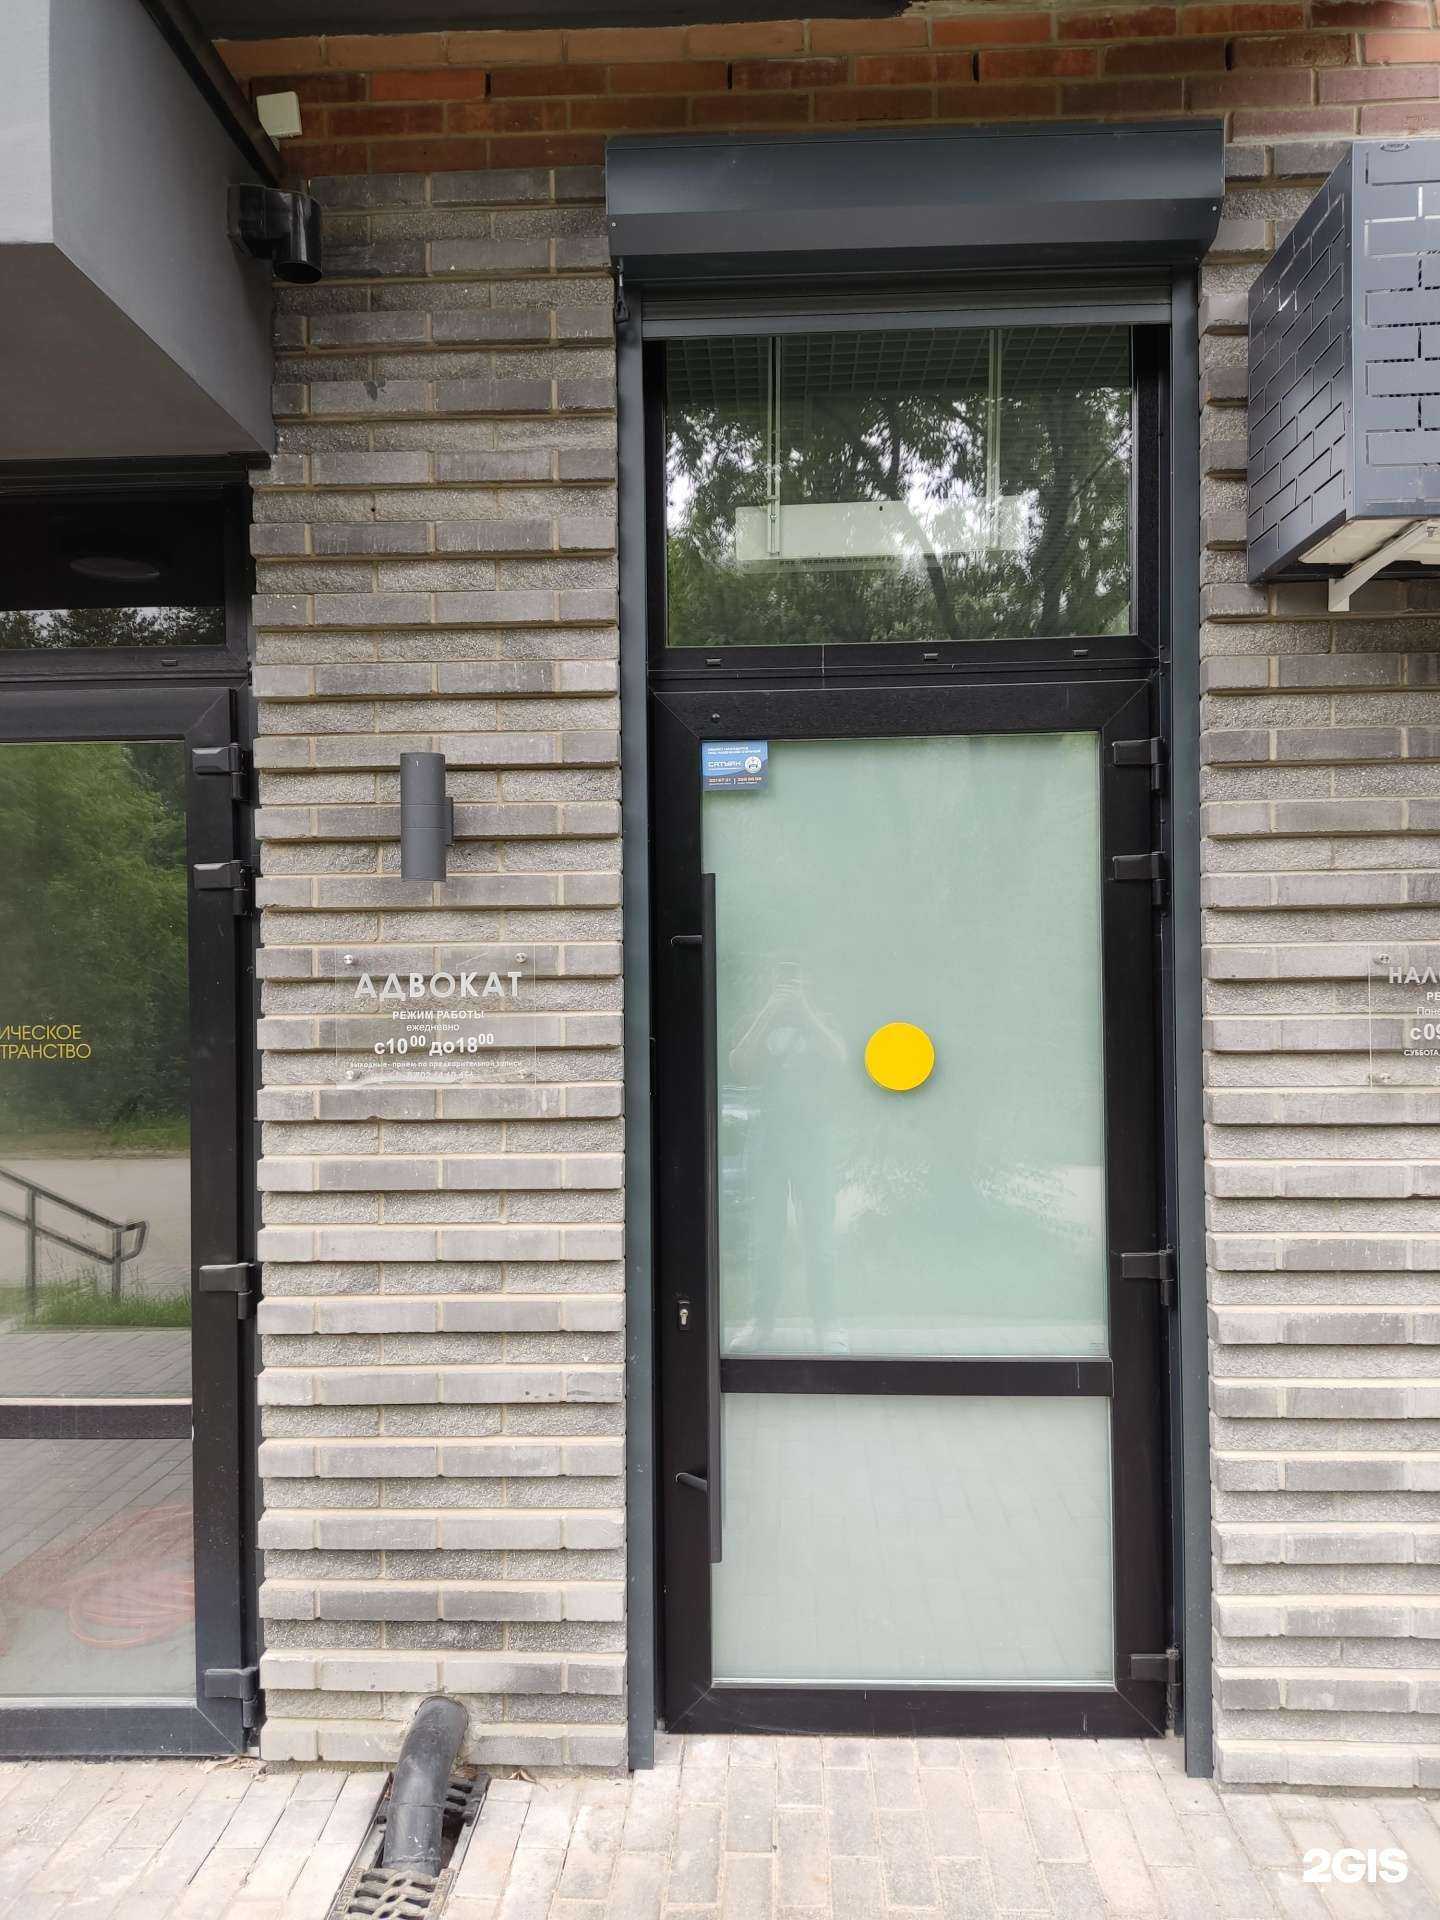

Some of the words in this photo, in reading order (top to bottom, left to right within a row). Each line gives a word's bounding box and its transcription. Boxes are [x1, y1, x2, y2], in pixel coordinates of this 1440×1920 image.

[1388, 966, 1440, 985] НАЛ
[354, 971, 522, 1002] АДВОКАТ
[392, 1010, 433, 1021] РЕЖИМ
[436, 1010, 485, 1020] РАБОТЫ
[406, 1023, 460, 1033] ежедневно
